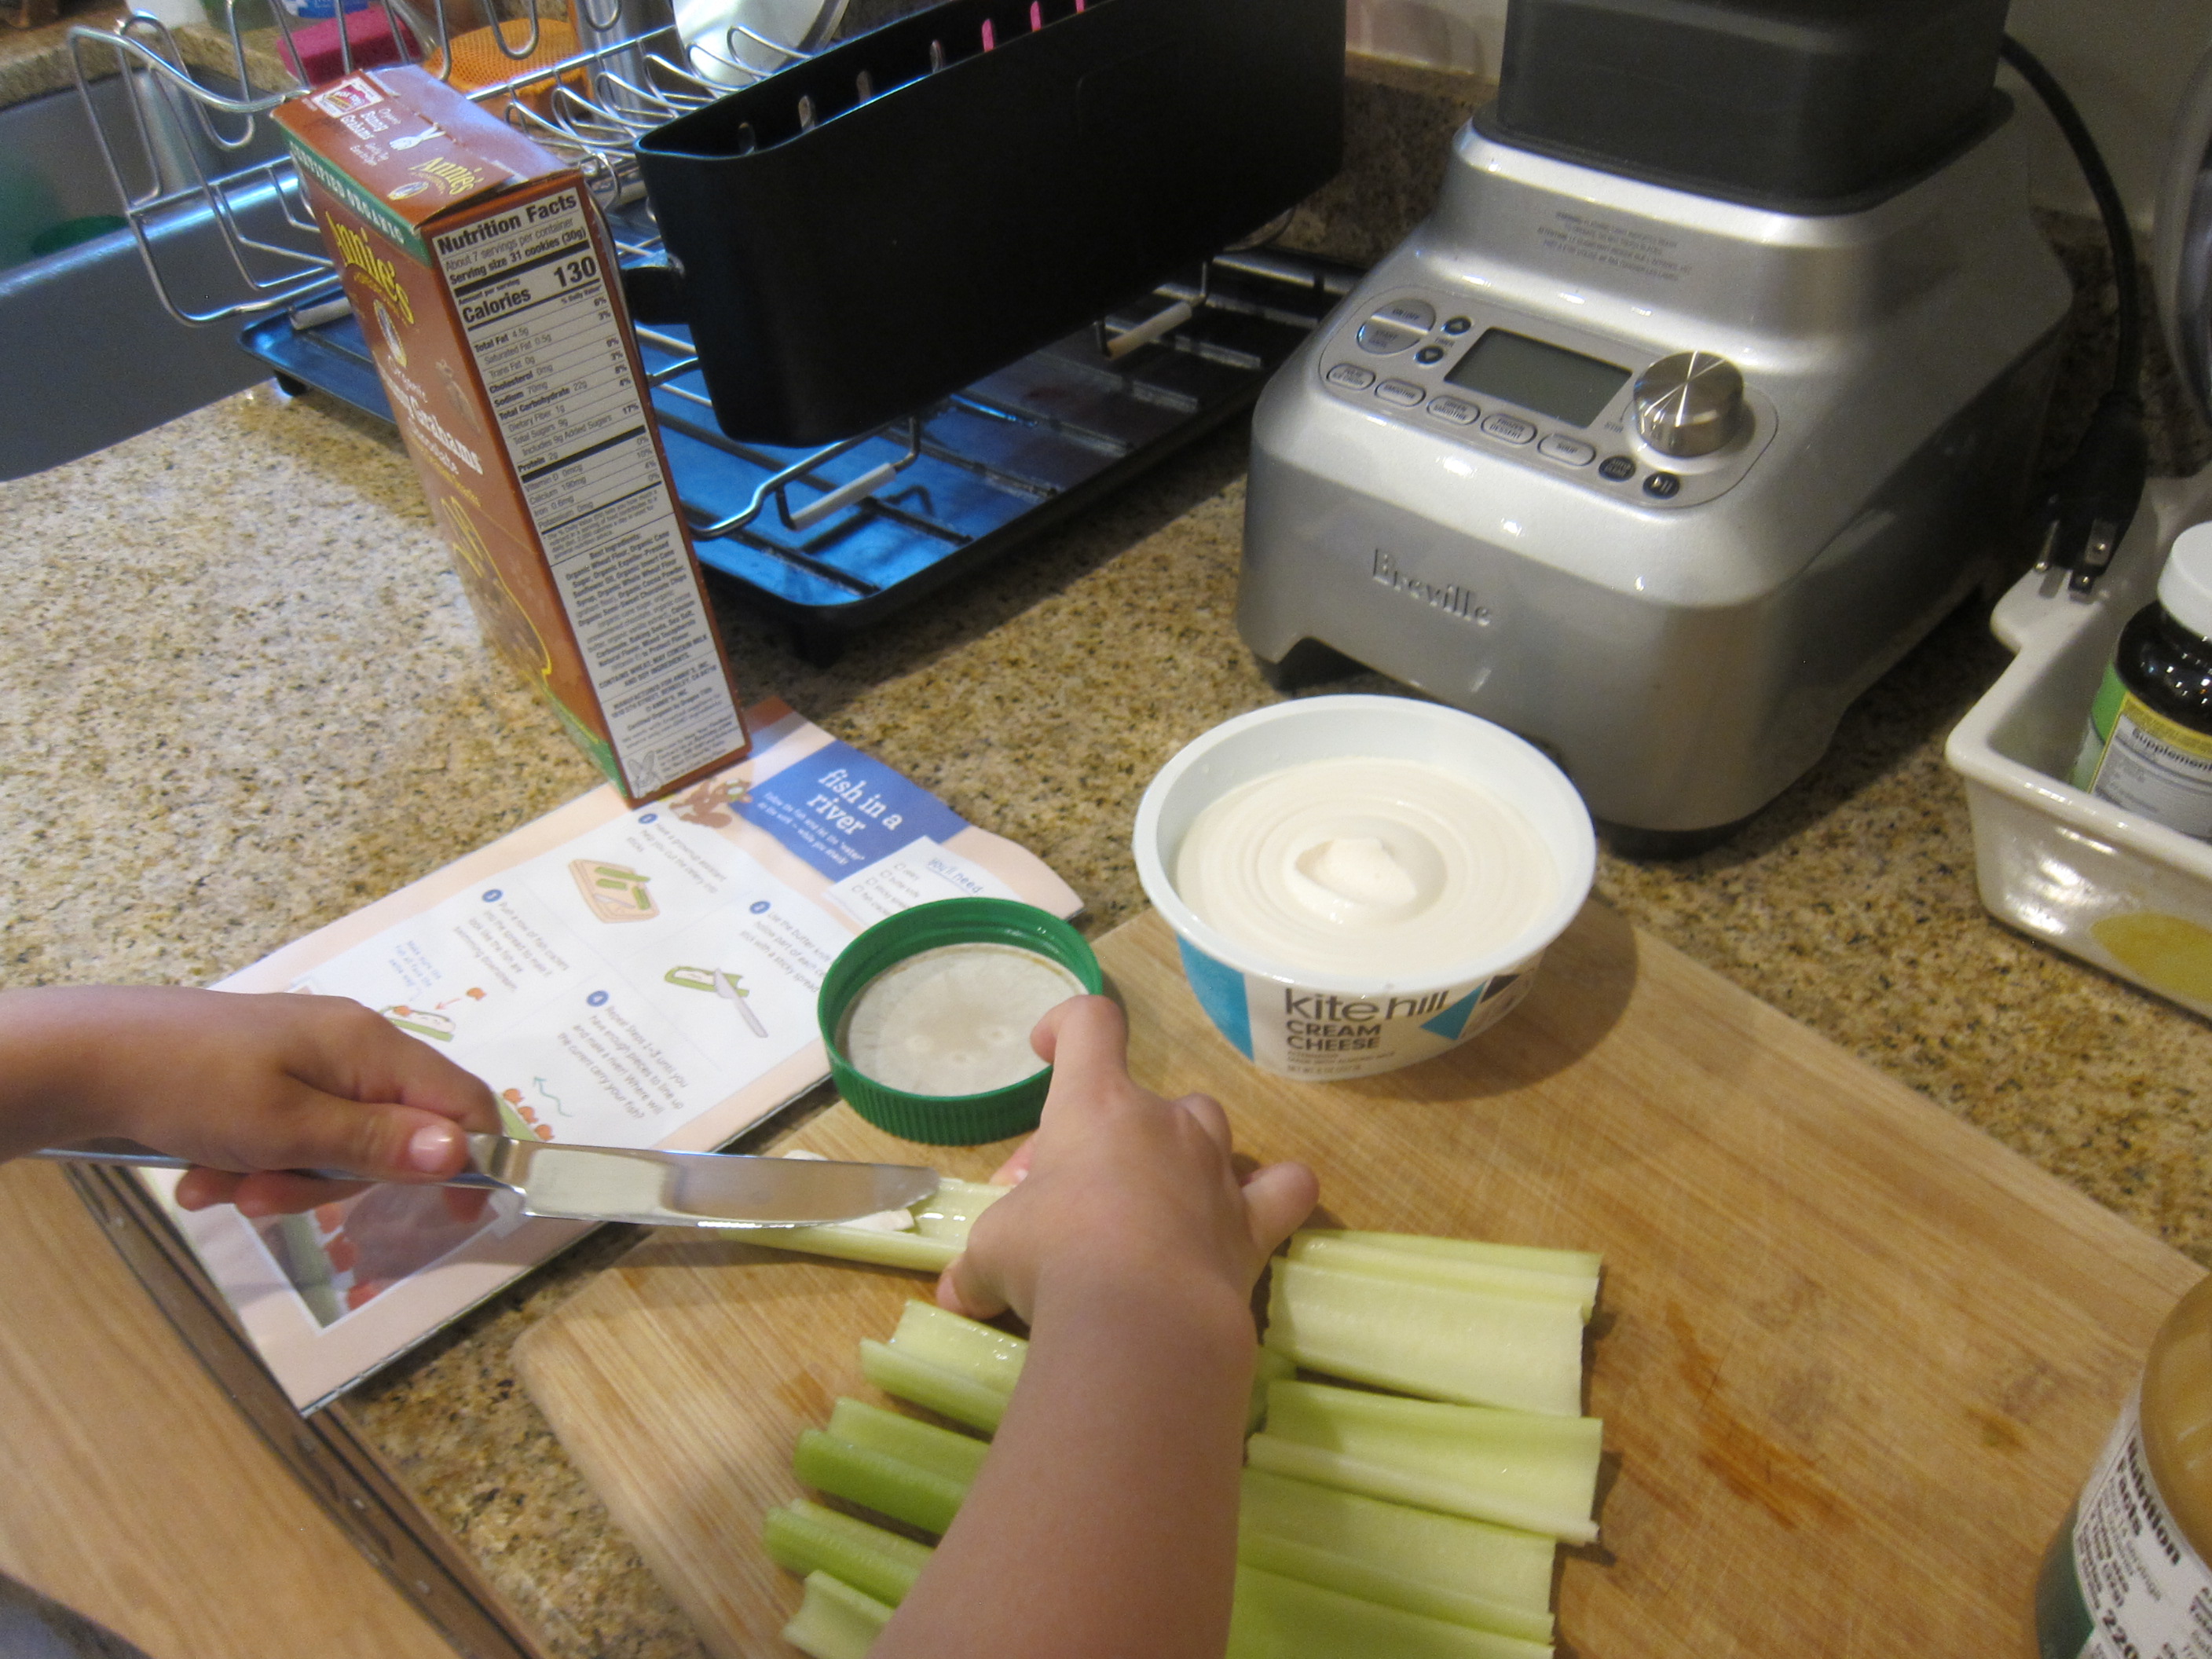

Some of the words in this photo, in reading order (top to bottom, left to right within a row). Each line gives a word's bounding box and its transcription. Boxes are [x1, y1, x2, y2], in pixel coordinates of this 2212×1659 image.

[435, 211, 522, 255] Nutrition
[524, 191, 577, 223] Facts
[443, 254, 472, 272] About
[471, 251, 479, 262] 7
[479, 236, 519, 261] servings
[517, 233, 533, 247] per
[533, 216, 574, 239] container
[448, 262, 487, 287] Serving
[486, 255, 507, 271] size
[509, 249, 522, 262] 31
[522, 235, 560, 258] cookies
[560, 225, 587, 246] (30g)
[460, 284, 532, 324] Calories
[551, 254, 599, 289] 130
[474, 338, 495, 353] Total
[494, 332, 509, 345] Fat
[511, 325, 530, 340] 4.5g
[483, 344, 519, 364] Saturated
[519, 339, 533, 351] Fat
[488, 370, 533, 394] Cholesterol
[535, 362, 553, 376] 0mg
[489, 364, 510, 378] Trans
[509, 359, 522, 370] Fat
[524, 353, 536, 366] 0g
[493, 390, 525, 408] Sodium
[499, 407, 518, 420] Total
[518, 386, 571, 413] Carbohydrate
[572, 379, 588, 392] 22g
[507, 416, 534, 433] Dietary
[533, 408, 551, 422] Fiber
[513, 432, 529, 445] Total
[530, 422, 556, 439] Sugars
[517, 455, 546, 473] Protein
[1373, 548, 1490, 628] Breville
[806, 793, 866, 835] river
[818, 767, 866, 804] fish
[858, 794, 888, 819] in
[881, 813, 903, 831] a
[1285, 987, 1379, 1021] kite
[1287, 1020, 1381, 1036] CREAM
[1287, 1035, 1380, 1051] CHEESE
[555, 1031, 573, 1046] the
[567, 1044, 594, 1068] current
[585, 1065, 611, 1086] carry
[602, 1082, 628, 1103] your
[621, 1100, 646, 1120] fish?
[624, 1052, 654, 1078] pieces
[649, 1075, 663, 1085] to
[657, 1082, 679, 1099] line
[669, 1098, 686, 1110] up
[655, 1056, 676, 1074] until
[668, 1073, 689, 1090] you
[621, 1073, 654, 1101] Where
[645, 1098, 665, 1115] will
